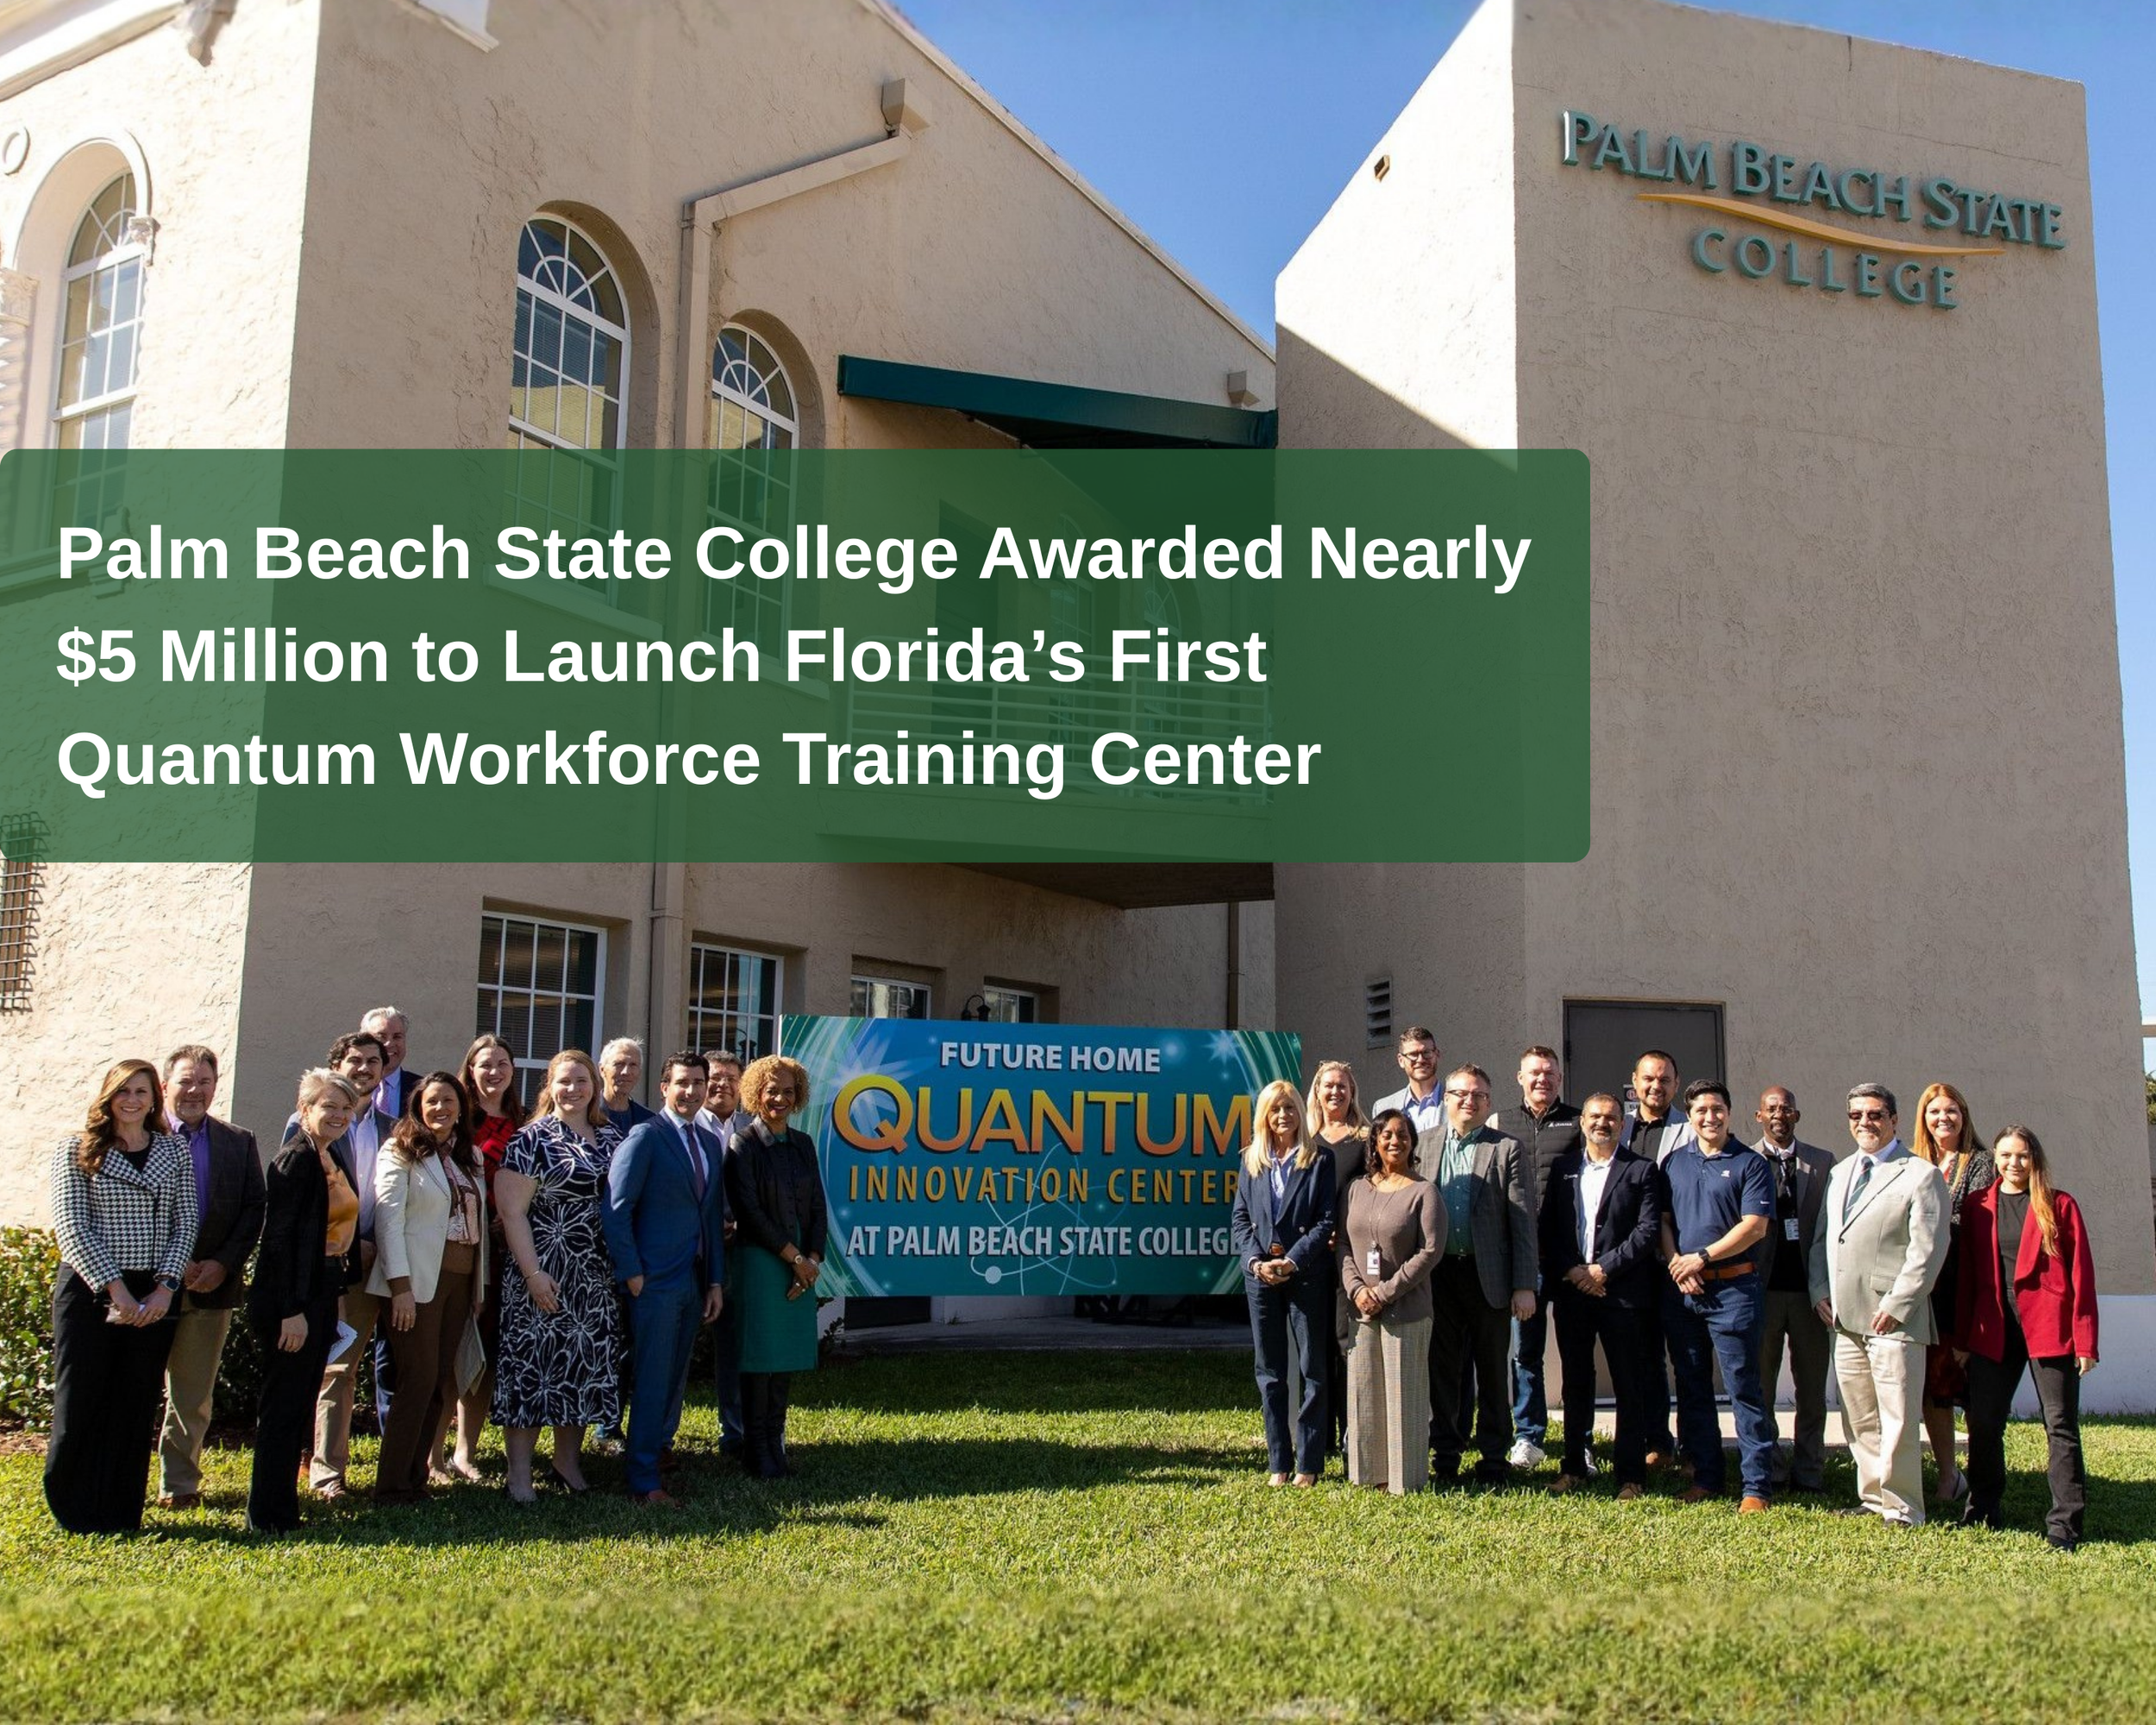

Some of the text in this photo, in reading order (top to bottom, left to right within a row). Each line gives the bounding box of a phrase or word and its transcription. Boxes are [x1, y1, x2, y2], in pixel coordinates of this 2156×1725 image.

[1562, 110, 2065, 250] PALM BEACH STATE
[1692, 227, 1958, 309] COLLEGE
[941, 1042, 1161, 1073] FUTURE HOME
[832, 1074, 1250, 1156] QUANTUM
[849, 1165, 1238, 1204] INNOVATION CENTER
[846, 1226, 881, 1258] AT
[887, 1226, 961, 1256] PALM
[968, 1226, 1049, 1256] BEACH
[1060, 1226, 1132, 1256] STATE
